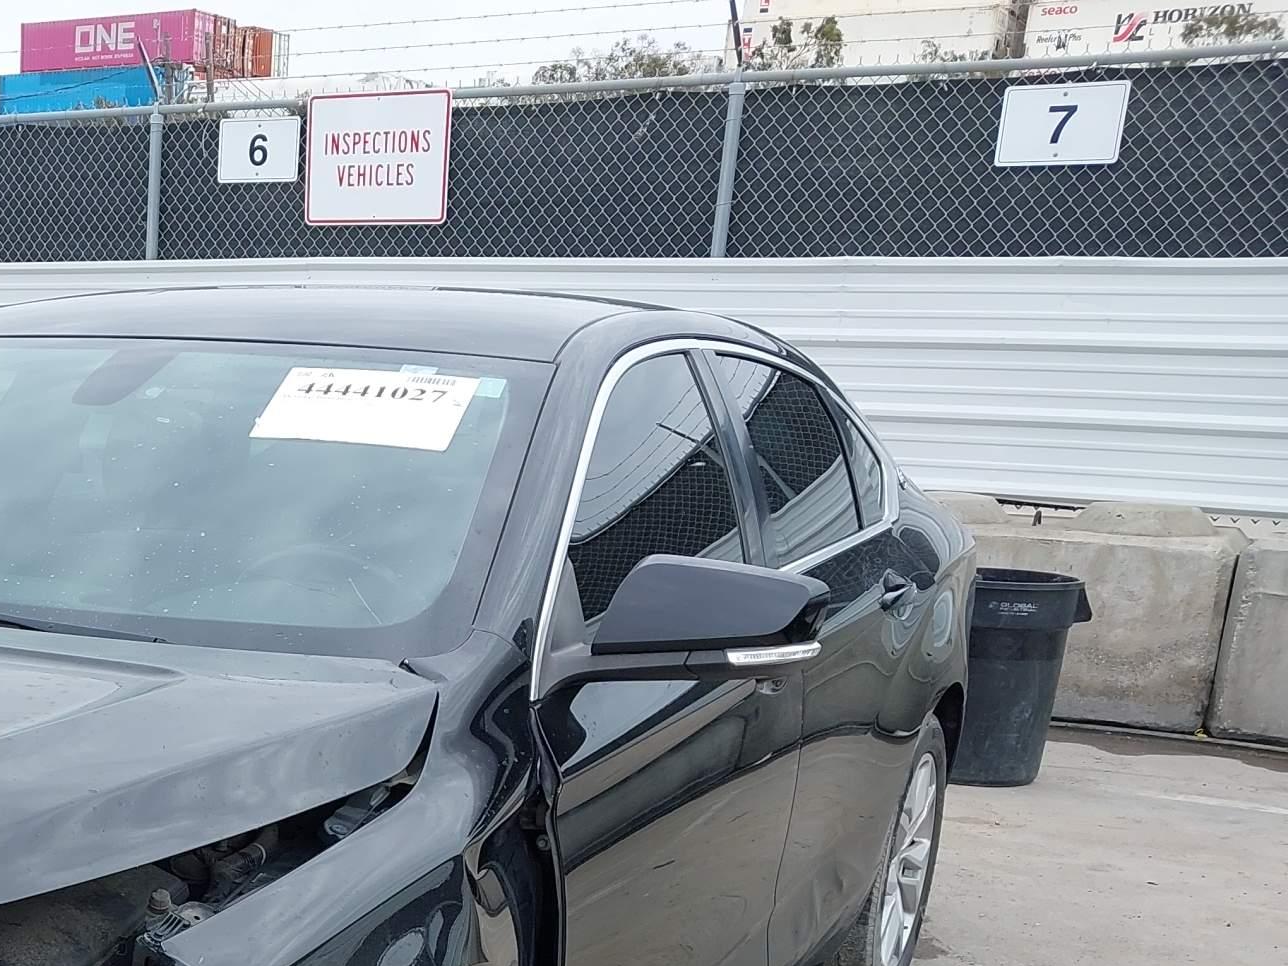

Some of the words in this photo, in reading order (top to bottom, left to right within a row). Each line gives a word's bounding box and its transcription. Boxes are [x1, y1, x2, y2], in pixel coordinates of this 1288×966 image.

[1041, 5, 1078, 16] seaco
[1152, 3, 1253, 24] HORIZON
[75, 22, 135, 53] ONE
[1049, 105, 1078, 144] 7
[248, 133, 268, 167] 6
[324, 130, 431, 155] INSPECTIONS
[337, 163, 414, 187] VEHICLES
[297, 382, 448, 402] 44441027
